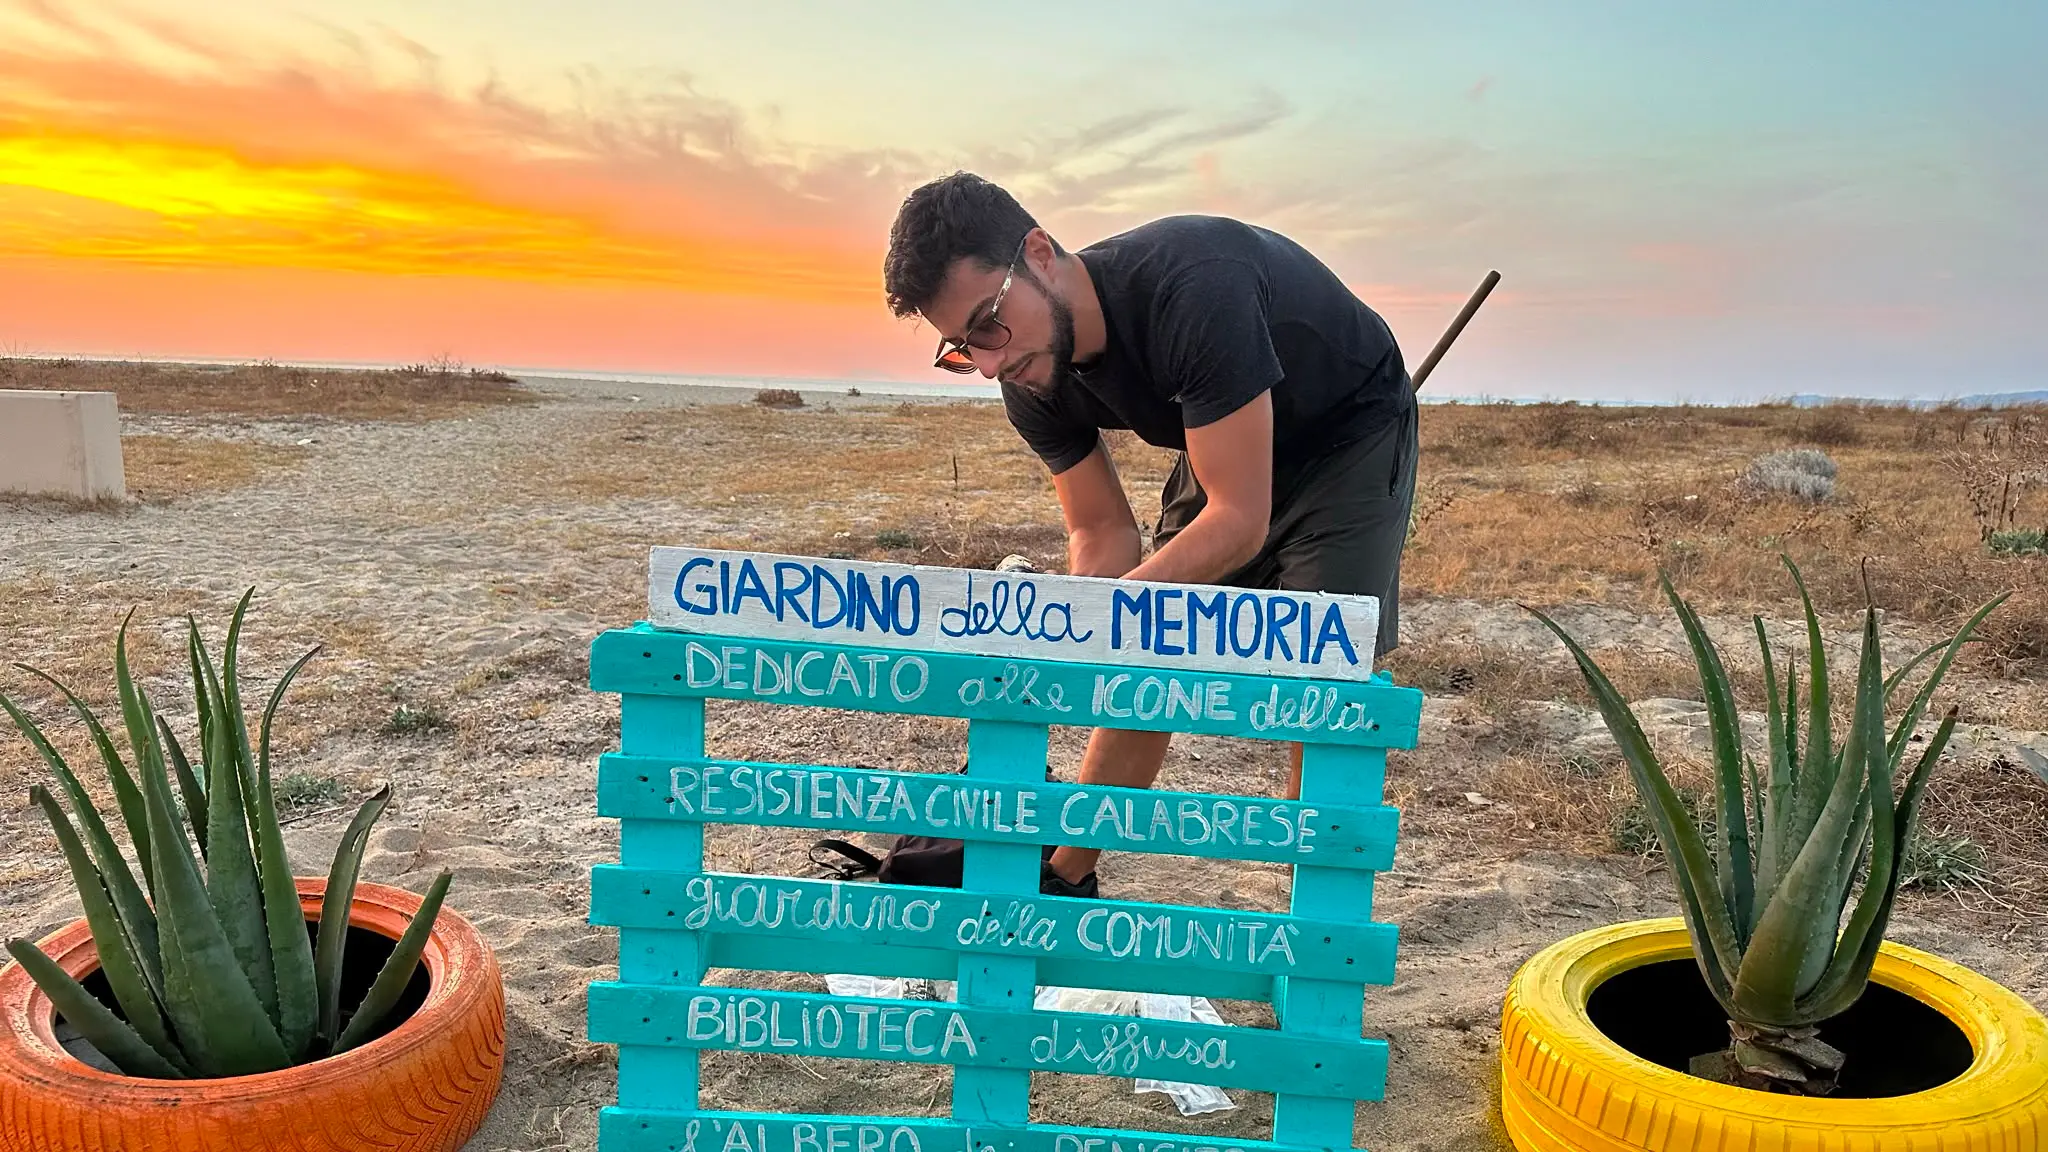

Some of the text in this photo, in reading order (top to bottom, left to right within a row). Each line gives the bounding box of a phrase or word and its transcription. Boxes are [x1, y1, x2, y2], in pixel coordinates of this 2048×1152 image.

[674, 557, 1359, 666] GIARDINO della MEMORIA
[687, 643, 1375, 731] DEDICATO alle ICONE della
[670, 767, 1320, 853] RESISTENZA CIVILE CALABRESE
[686, 877, 942, 932] giardino
[957, 900, 1058, 951] della
[1030, 1020, 1236, 1074] diffusa
